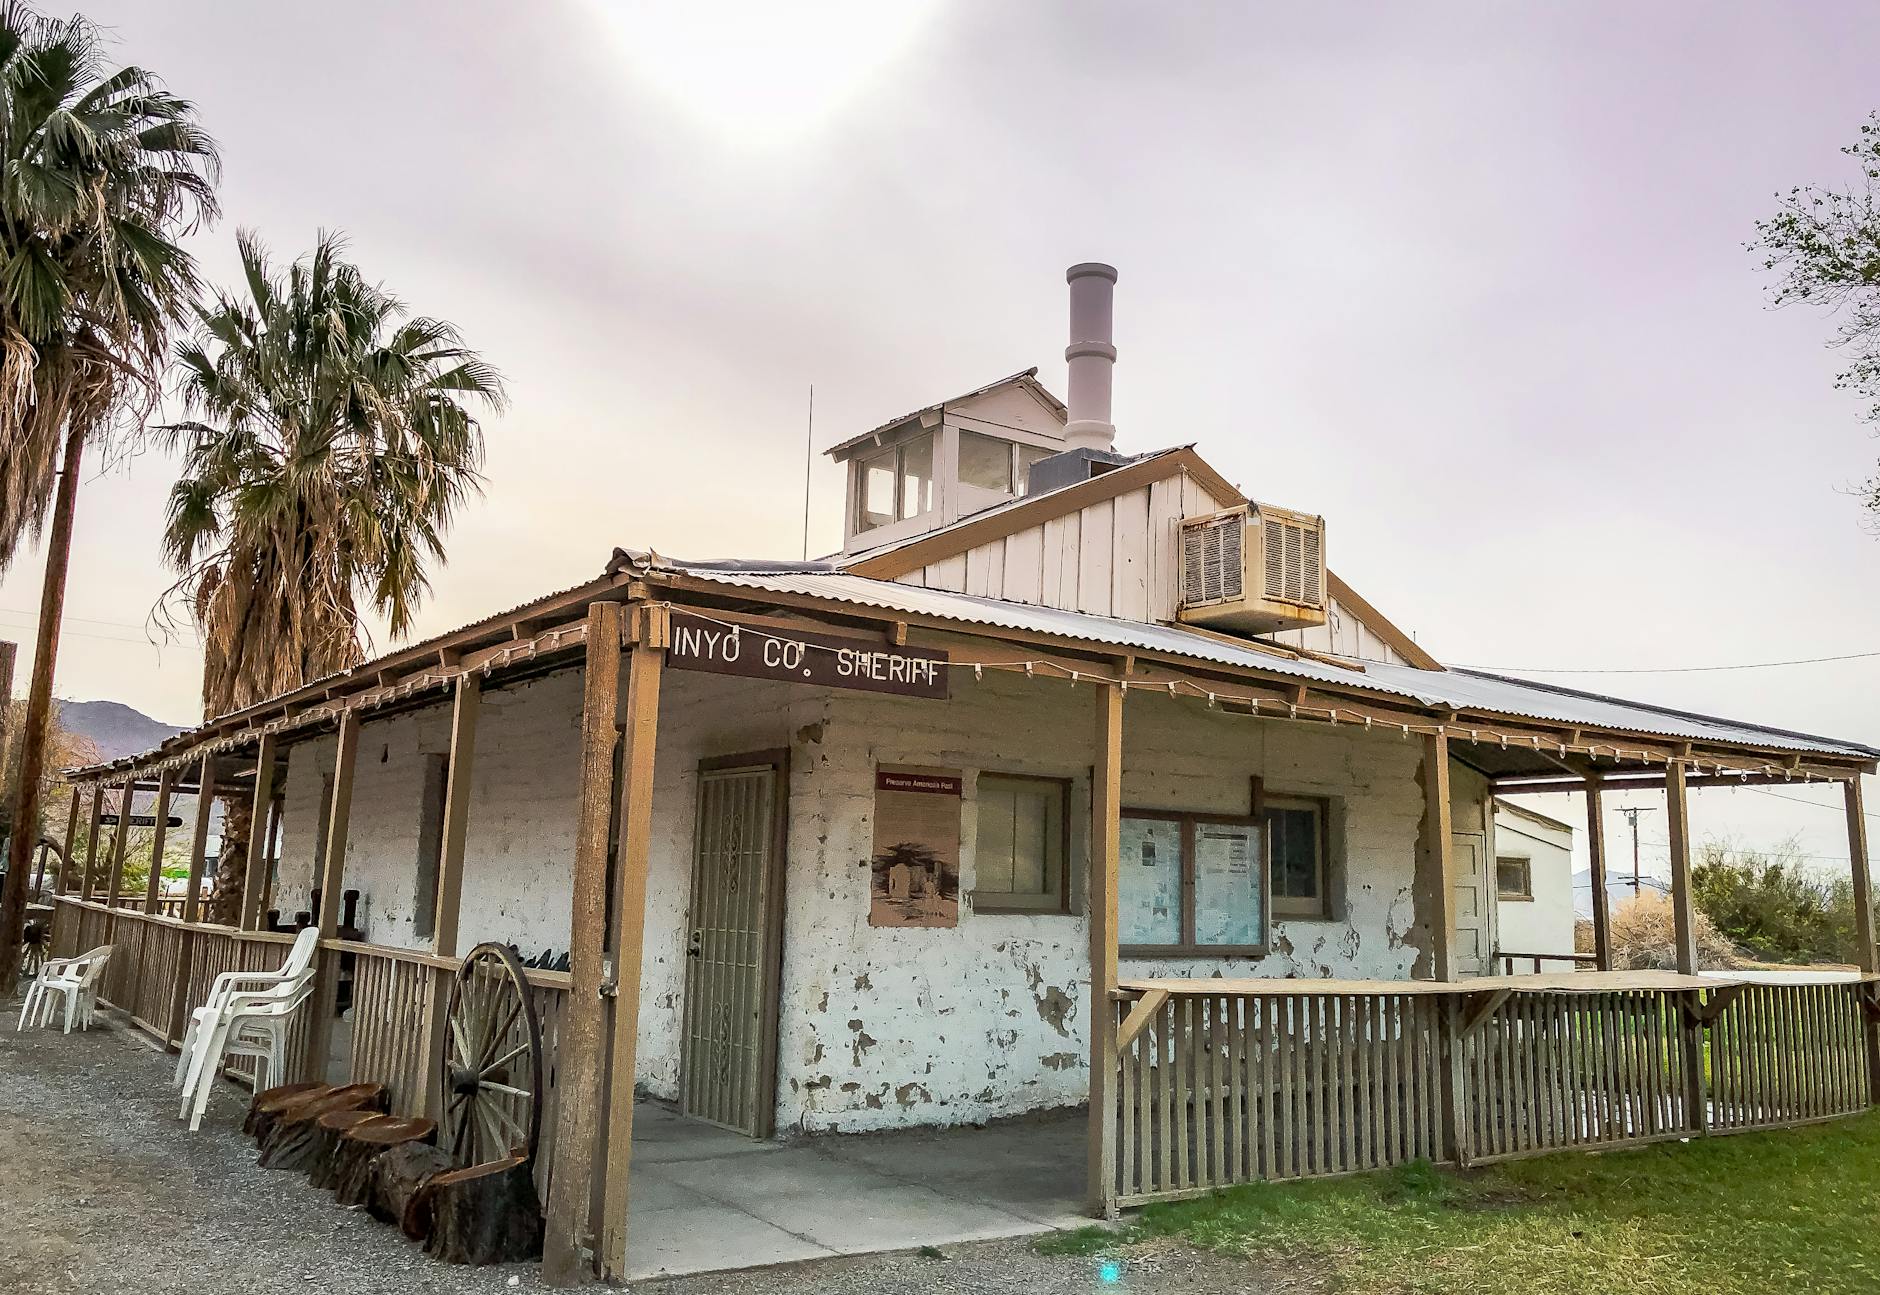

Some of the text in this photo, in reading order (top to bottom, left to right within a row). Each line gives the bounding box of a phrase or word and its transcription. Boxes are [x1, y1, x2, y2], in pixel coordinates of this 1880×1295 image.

[674, 626, 938, 686] INYO CO. SHERIFF
[886, 778, 911, 787] Preserve
